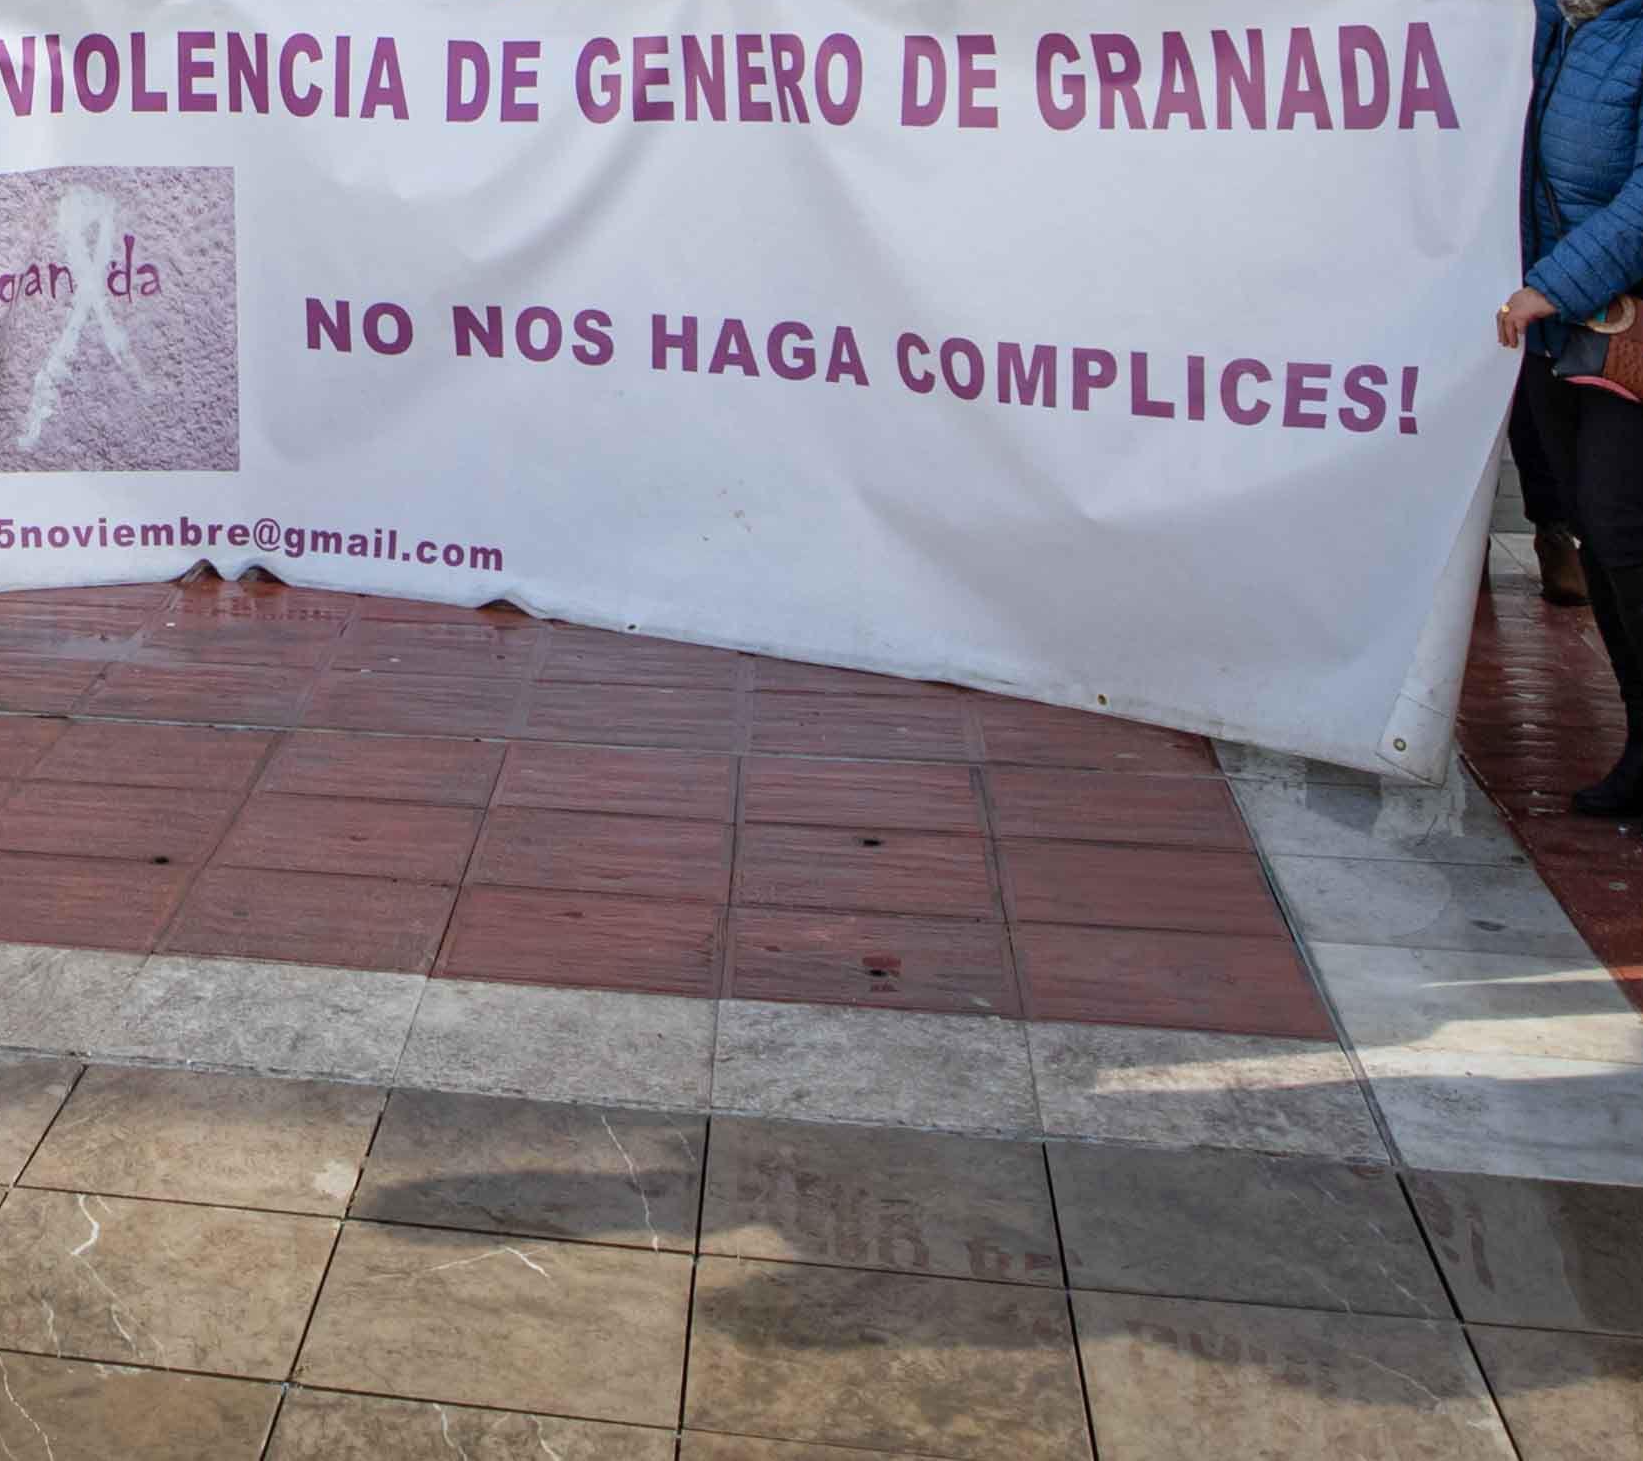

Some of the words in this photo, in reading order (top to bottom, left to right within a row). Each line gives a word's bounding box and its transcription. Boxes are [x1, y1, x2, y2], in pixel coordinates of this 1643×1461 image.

[444, 37, 543, 124] DE
[573, 30, 863, 125] GENERO
[898, 33, 998, 129] DE
[1034, 21, 1459, 131] GRANADA
[303, 296, 415, 355] NO
[451, 303, 614, 366] NOS
[650, 313, 870, 388] HAGA
[894, 331, 1419, 435] COMPLICES!
